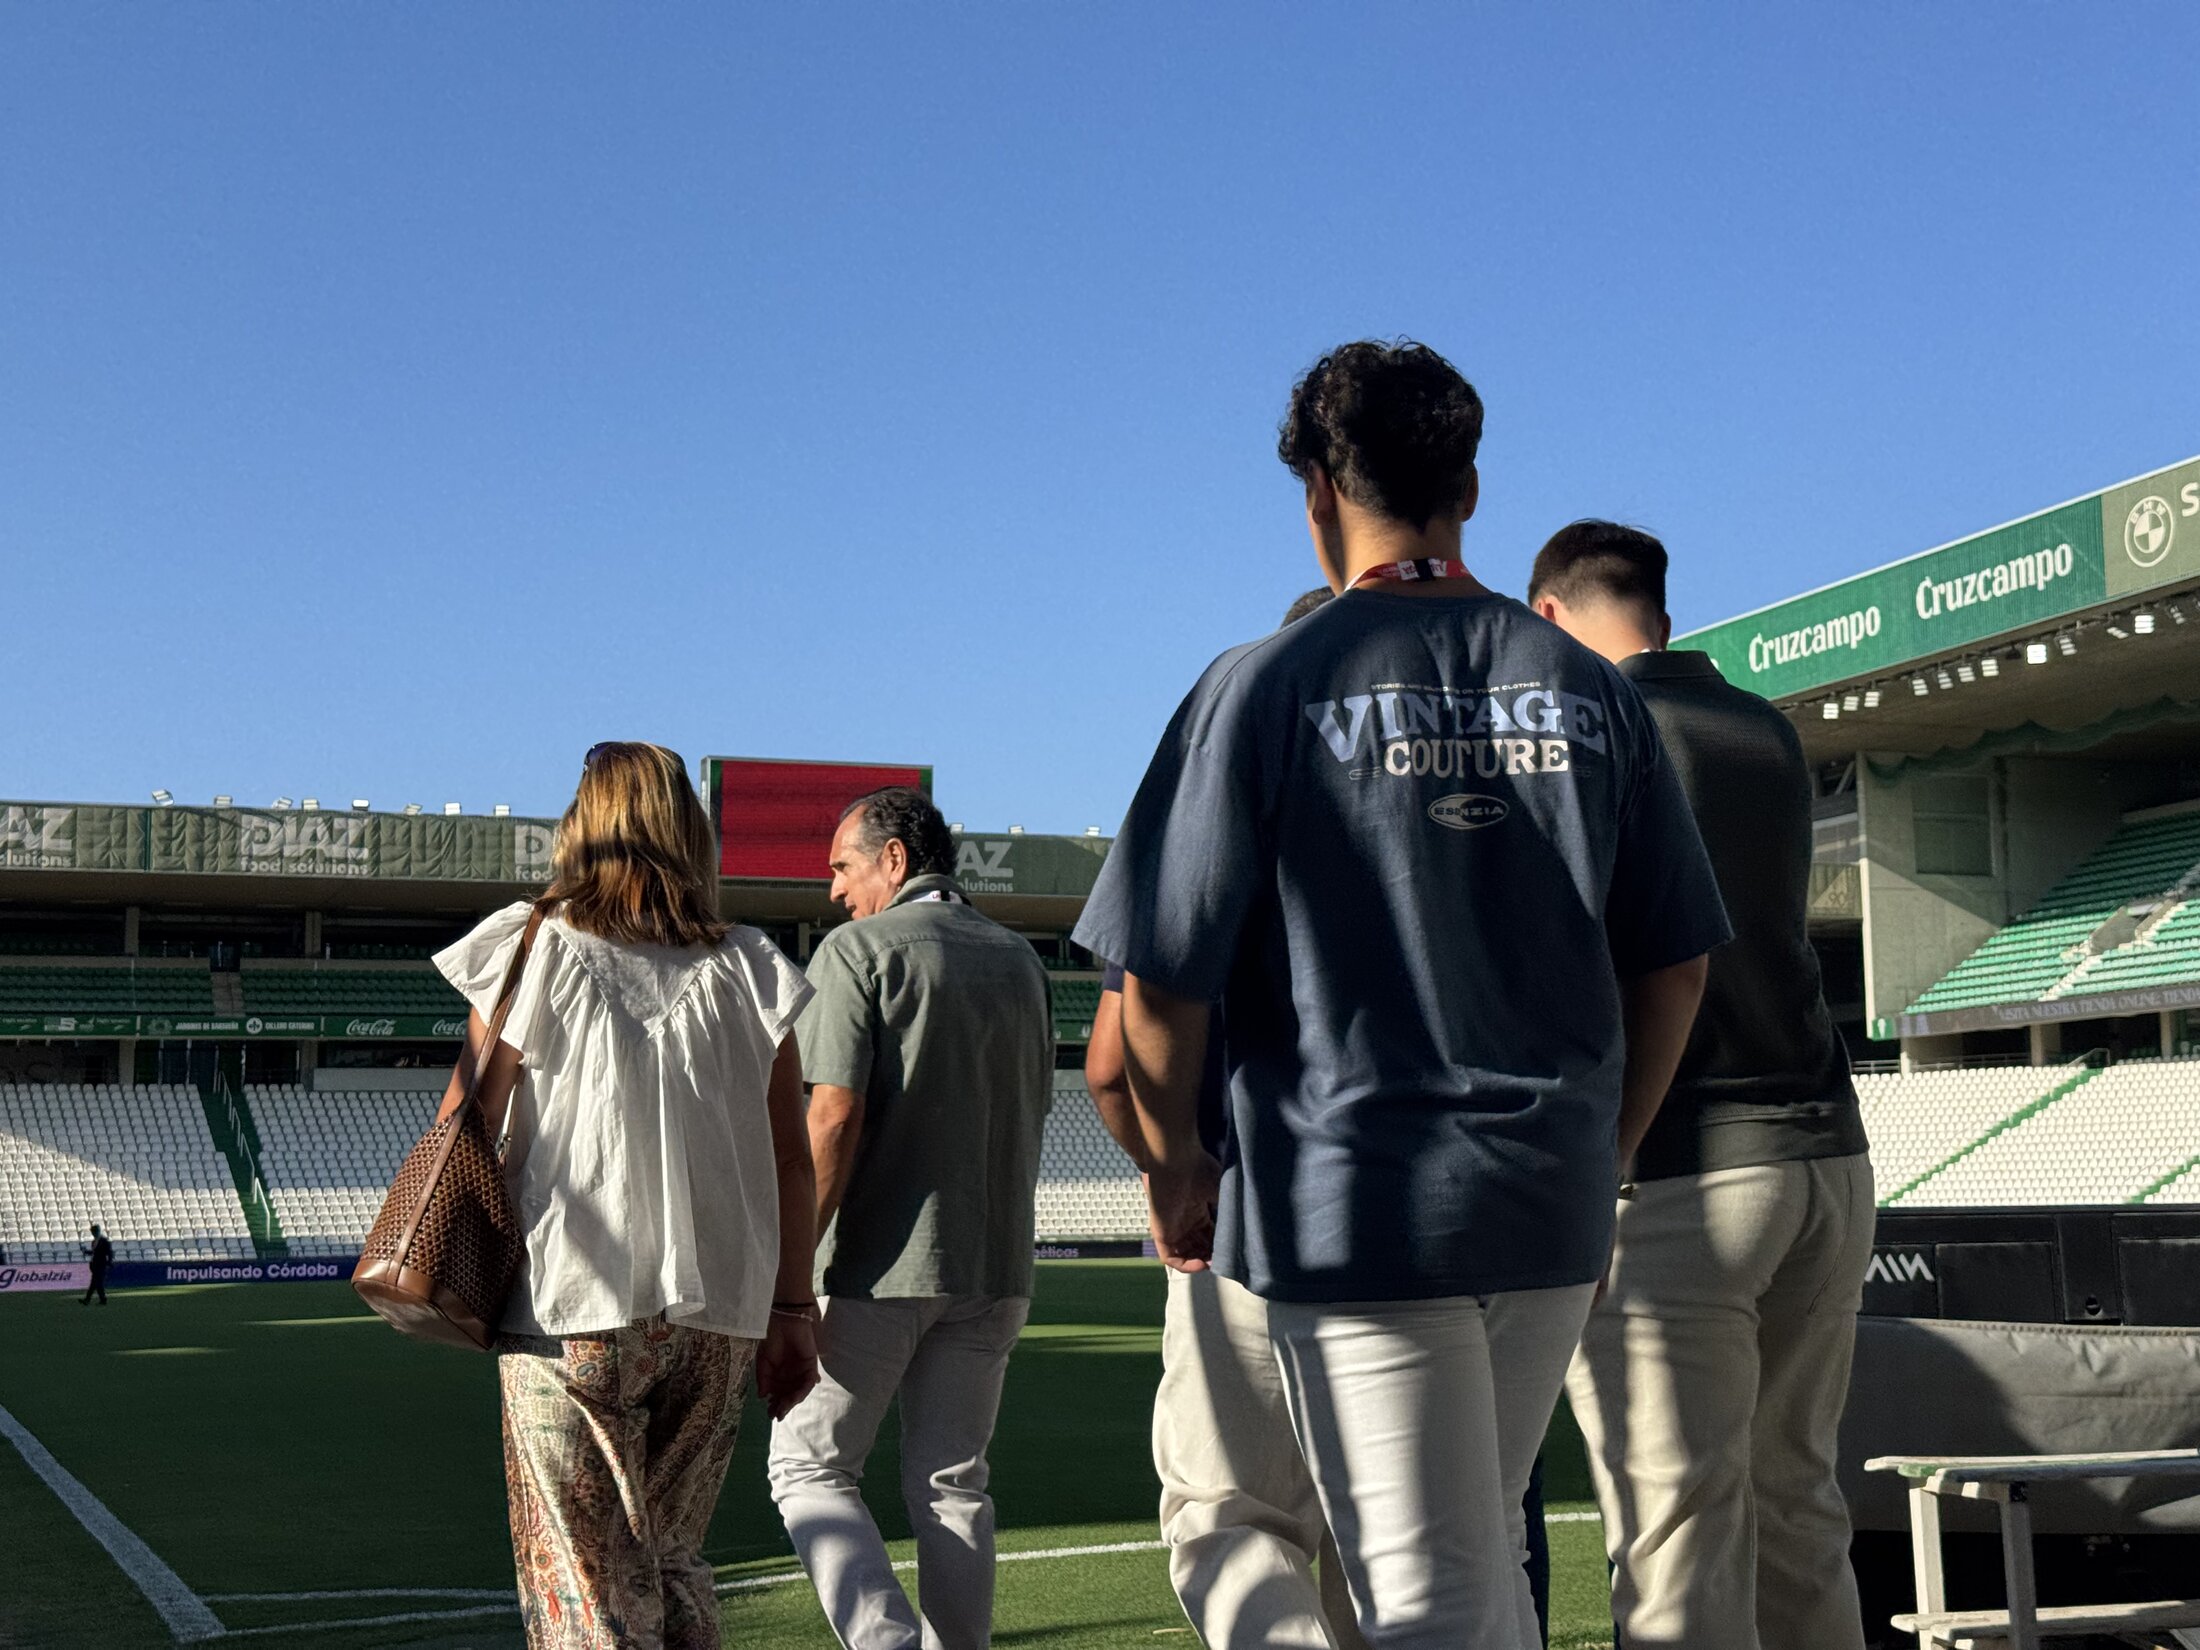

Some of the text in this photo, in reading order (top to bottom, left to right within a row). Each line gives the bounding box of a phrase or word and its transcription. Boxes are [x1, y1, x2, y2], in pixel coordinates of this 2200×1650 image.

[2130, 501, 2167, 524] BMW
[1916, 543, 2073, 619] Cruzcampo
[1749, 606, 1881, 673] Cruzcampo
[1502, 681, 1541, 691] CLOTHES
[1305, 689, 1606, 764] VINTAGE
[1384, 737, 1569, 779] COUTURE
[240, 814, 369, 859] DIAZ
[240, 858, 368, 875] food solutions
[167, 1262, 338, 1281] Impulsando Córdoba
